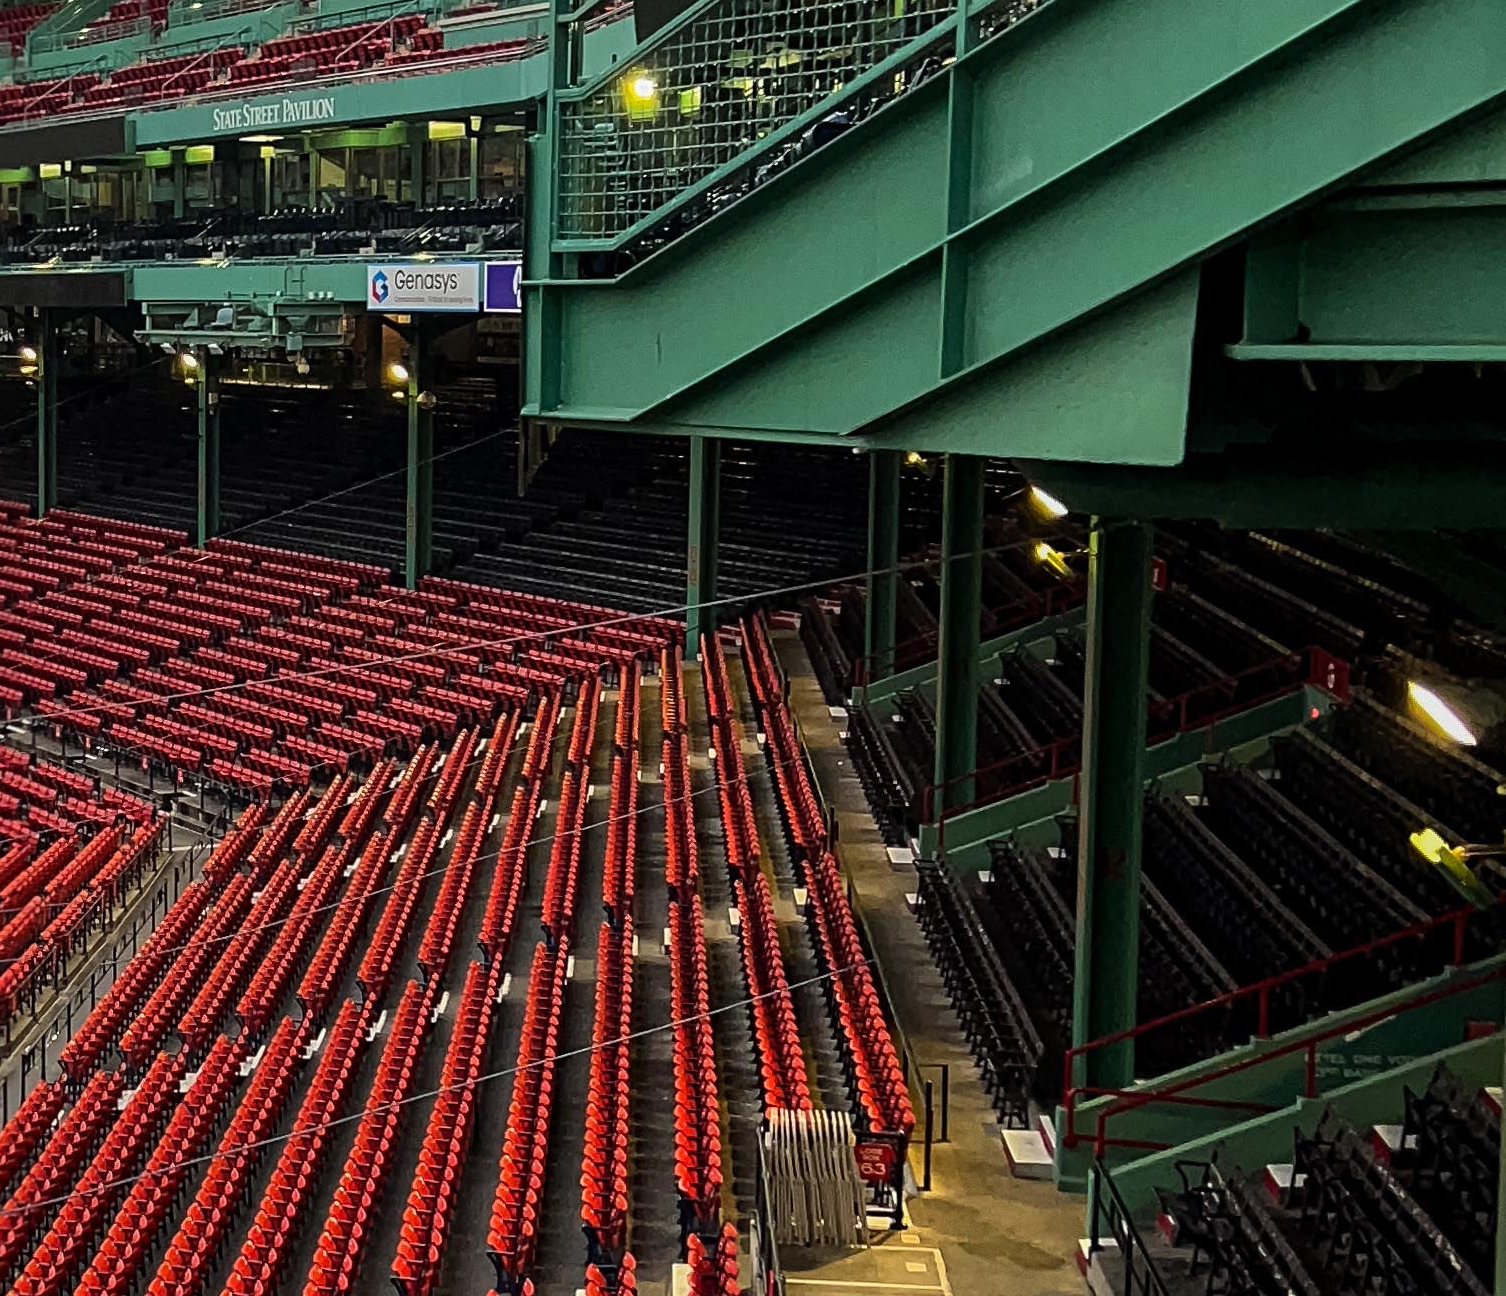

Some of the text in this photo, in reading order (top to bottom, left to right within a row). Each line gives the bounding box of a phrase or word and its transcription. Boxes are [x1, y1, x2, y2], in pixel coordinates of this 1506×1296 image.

[213, 98, 335, 131] STATE STREET PAVILION
[394, 269, 458, 294] Genasys
[861, 1163, 886, 1175] 63
